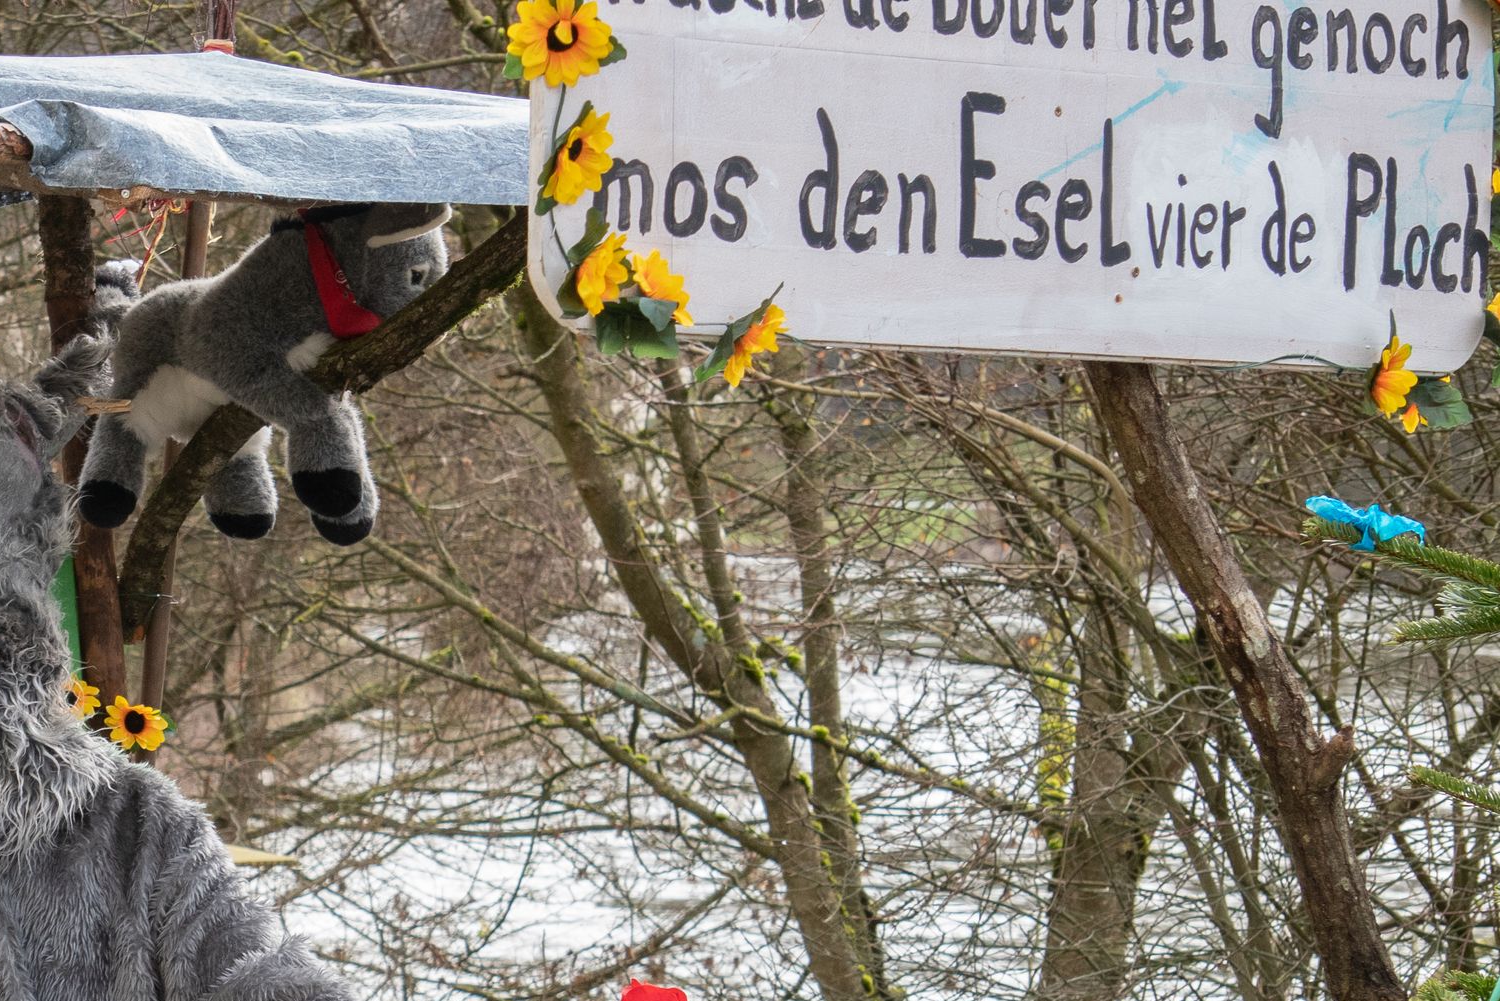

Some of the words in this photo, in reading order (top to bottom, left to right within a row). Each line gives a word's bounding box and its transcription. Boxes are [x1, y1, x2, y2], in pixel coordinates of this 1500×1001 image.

[844, 0, 909, 32] e
[933, 0, 1097, 50] ouer
[1252, 0, 1470, 139] genoch
[594, 155, 760, 243] mos
[800, 107, 937, 254] den
[1146, 173, 1247, 271] vier
[1261, 160, 1316, 277] de
